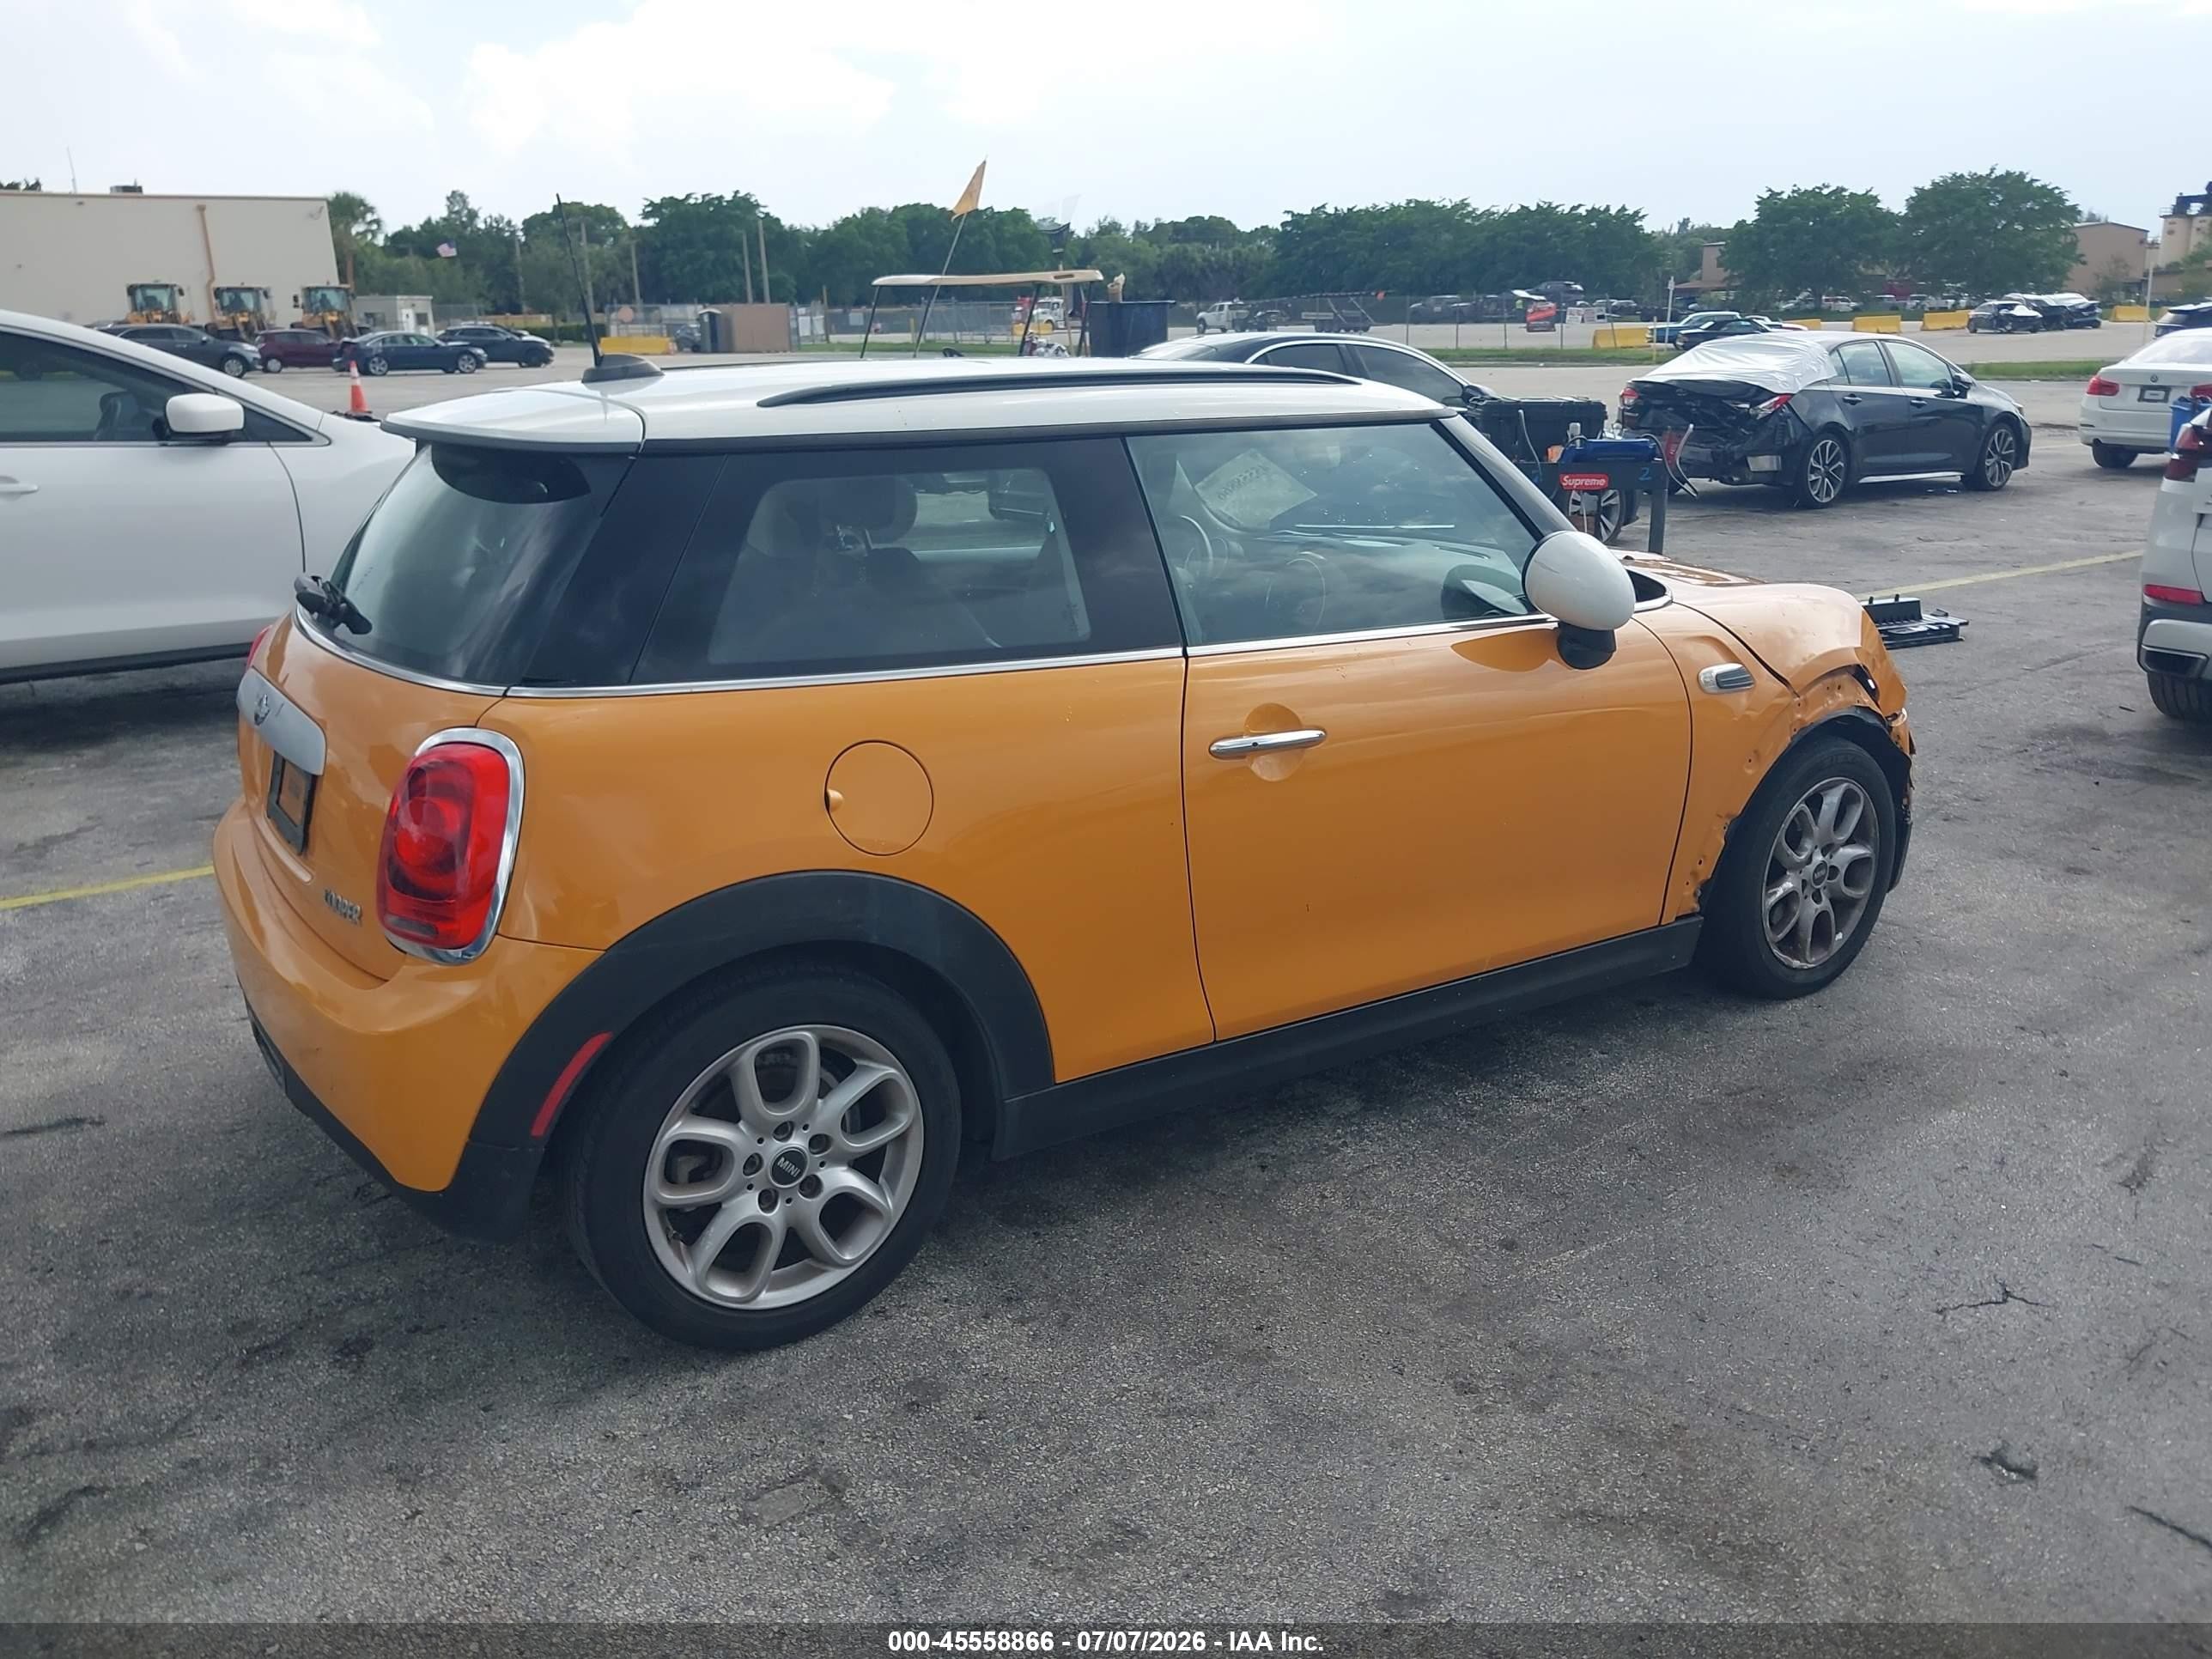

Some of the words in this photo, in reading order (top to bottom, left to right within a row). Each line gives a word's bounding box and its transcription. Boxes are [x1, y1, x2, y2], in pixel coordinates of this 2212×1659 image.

[1638, 466, 1652, 481] 2
[1562, 475, 1606, 489] Supreme
[777, 1157, 800, 1177] MINI
